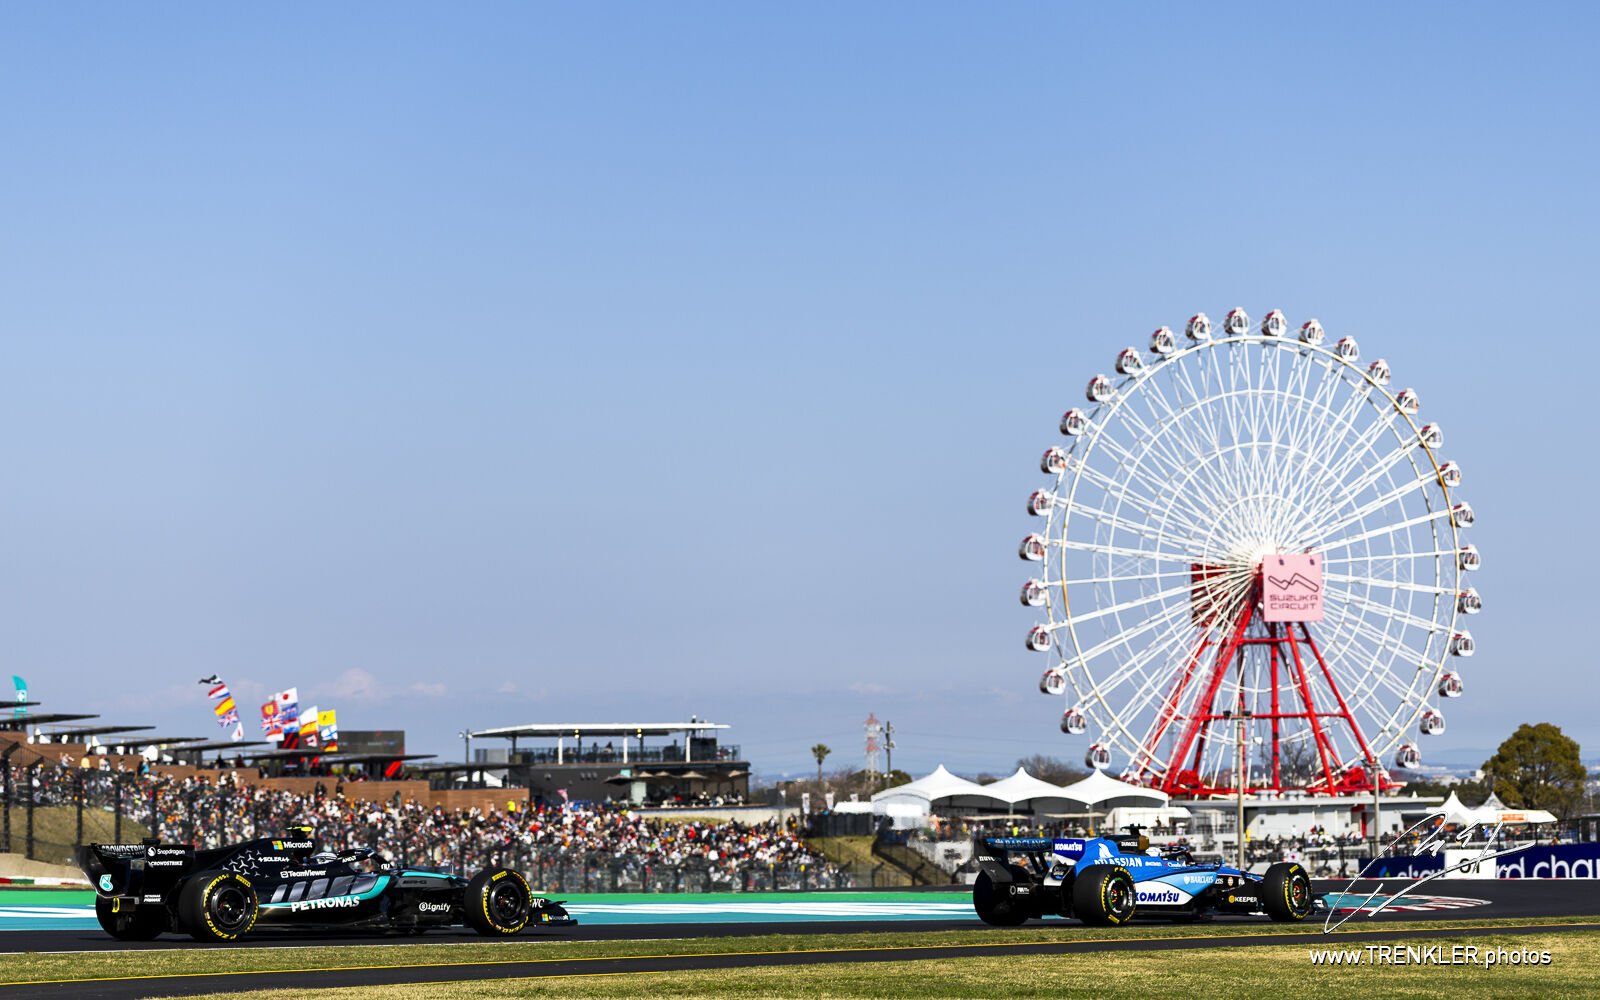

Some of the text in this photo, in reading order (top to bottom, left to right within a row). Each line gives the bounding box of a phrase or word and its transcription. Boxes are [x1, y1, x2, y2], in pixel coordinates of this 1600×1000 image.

[283, 840, 313, 849] Microsoft
[1054, 842, 1083, 851] KOMATSU
[1190, 876, 1214, 884] BARCLAYS
[291, 896, 361, 912] PETRONAS
